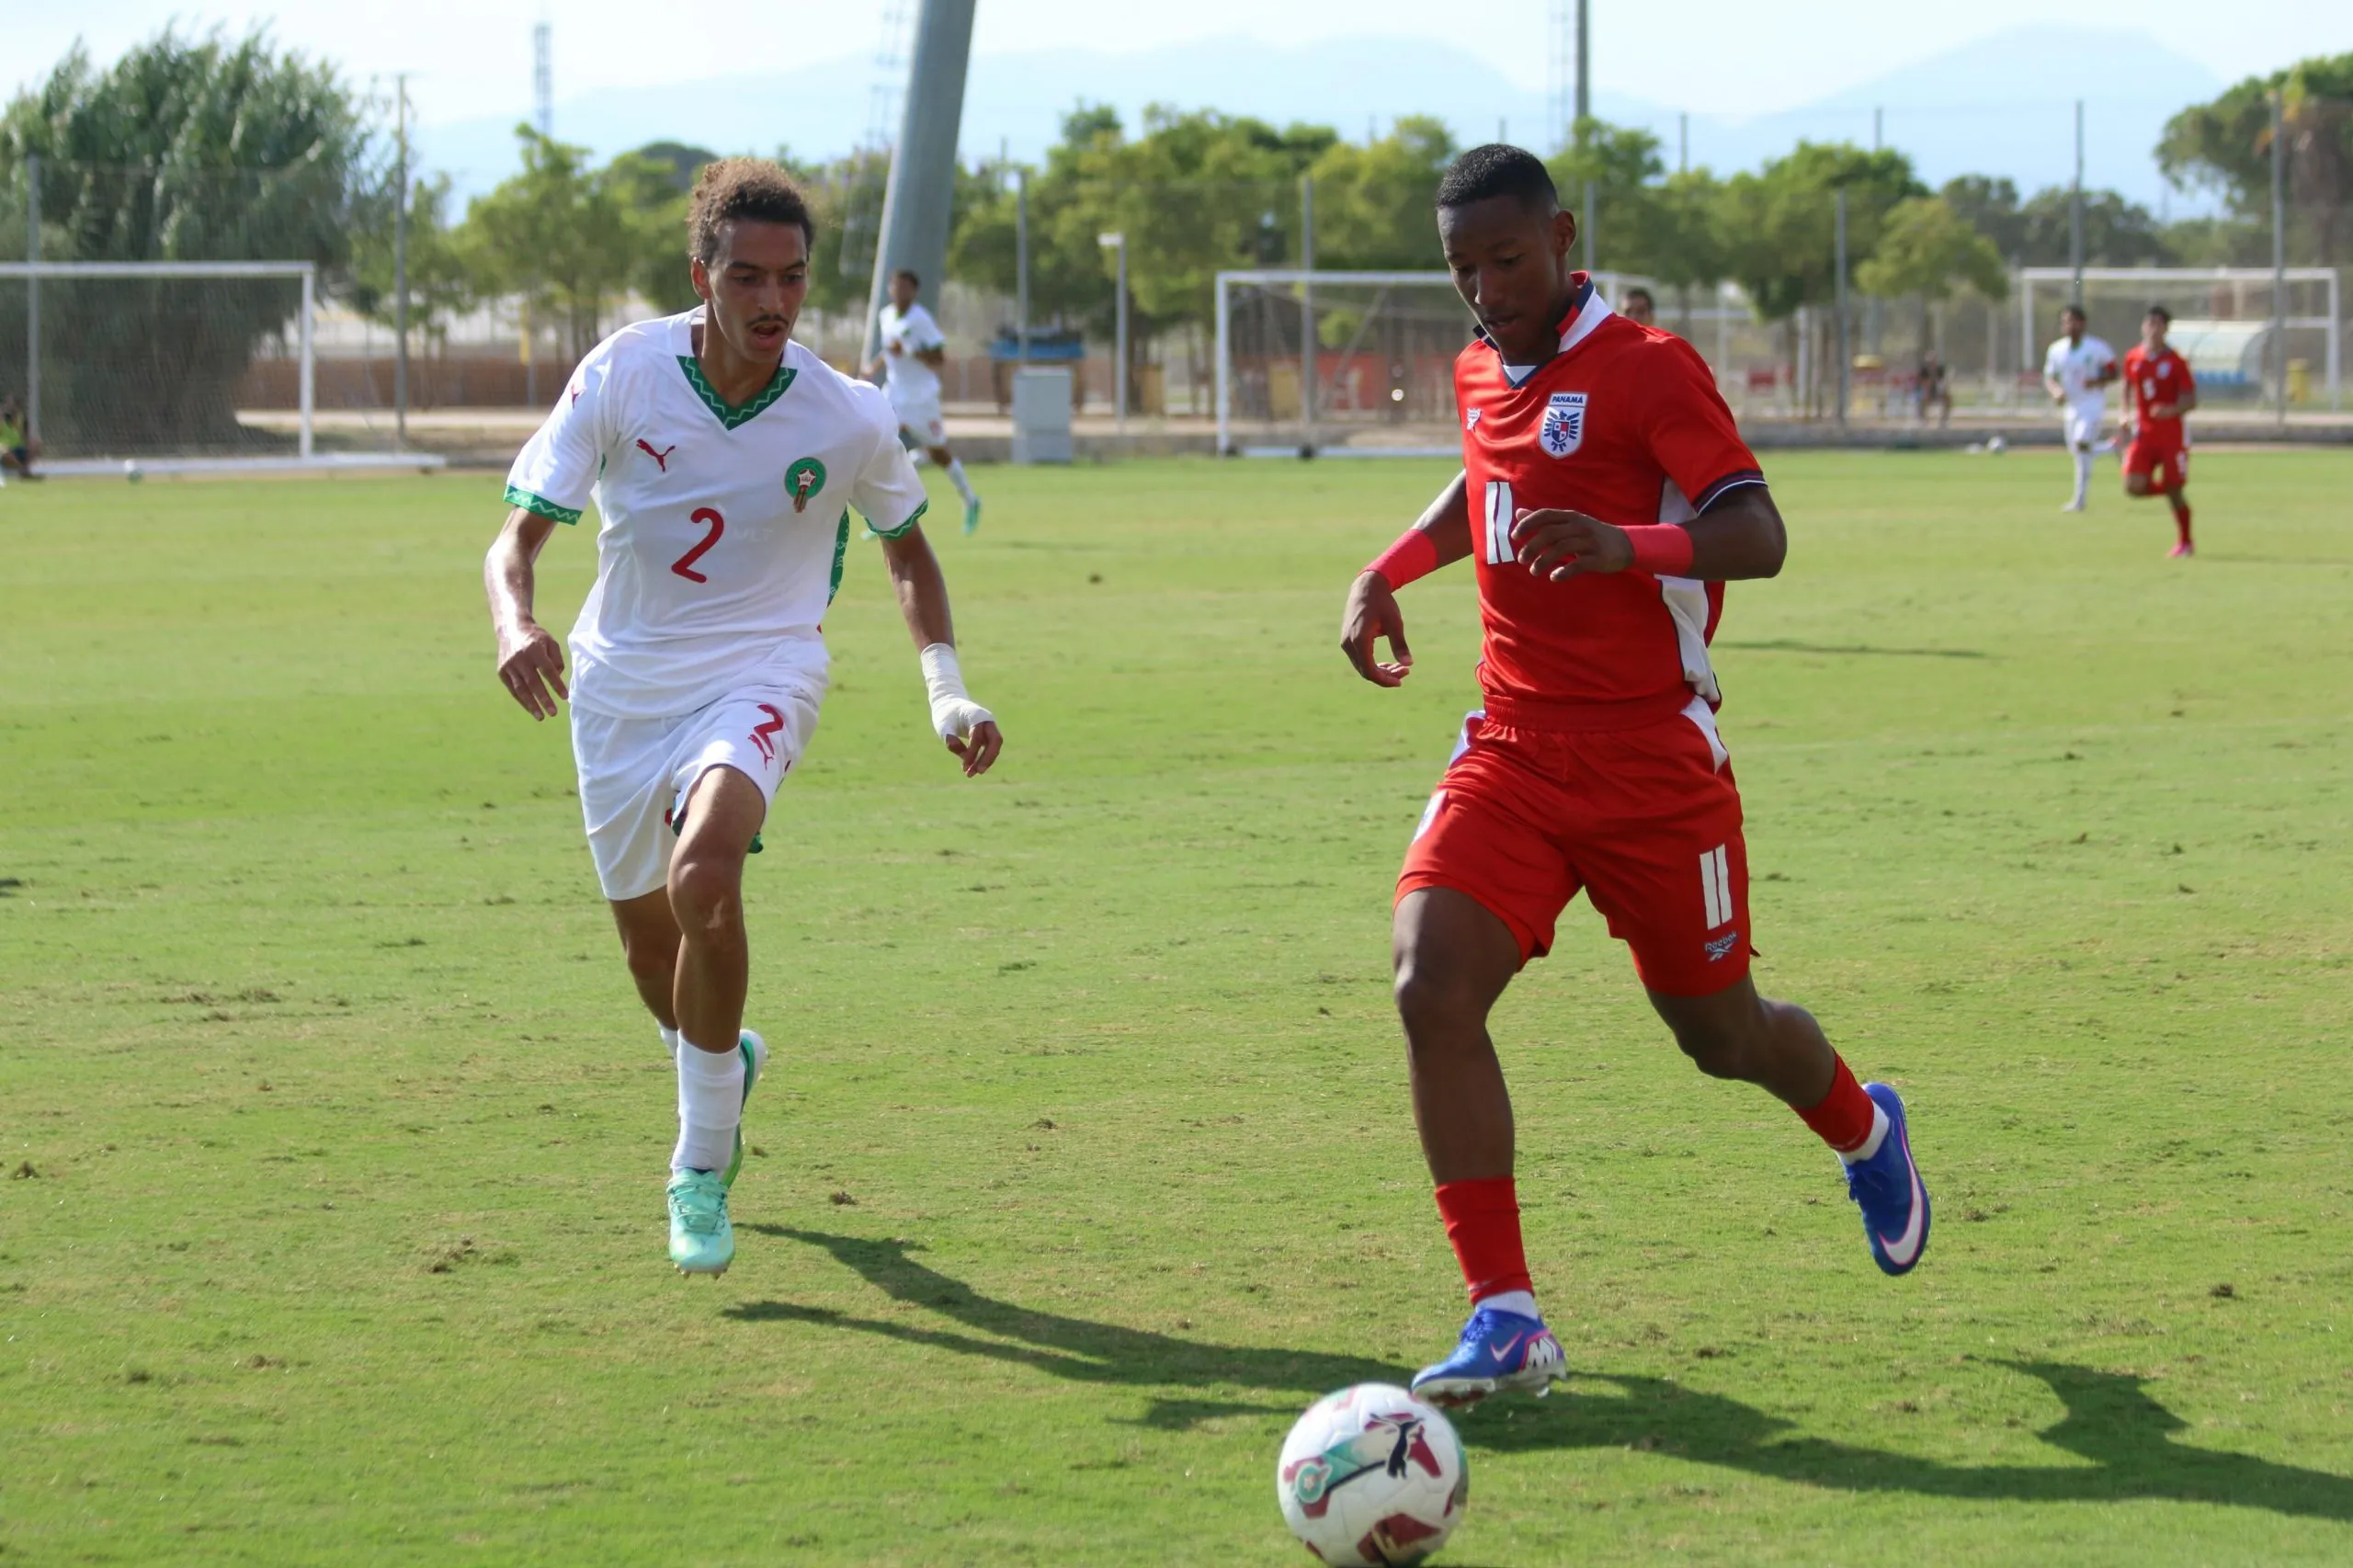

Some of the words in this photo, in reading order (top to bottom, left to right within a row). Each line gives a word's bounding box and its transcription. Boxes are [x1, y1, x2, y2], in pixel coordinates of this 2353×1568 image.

[1552, 395, 1583, 404] PANAMÁ
[671, 507, 724, 584] 2
[1485, 481, 1516, 565] 11
[754, 703, 784, 755] 2
[1699, 843, 1733, 931] 11
[1705, 930, 1736, 951] Reebok
